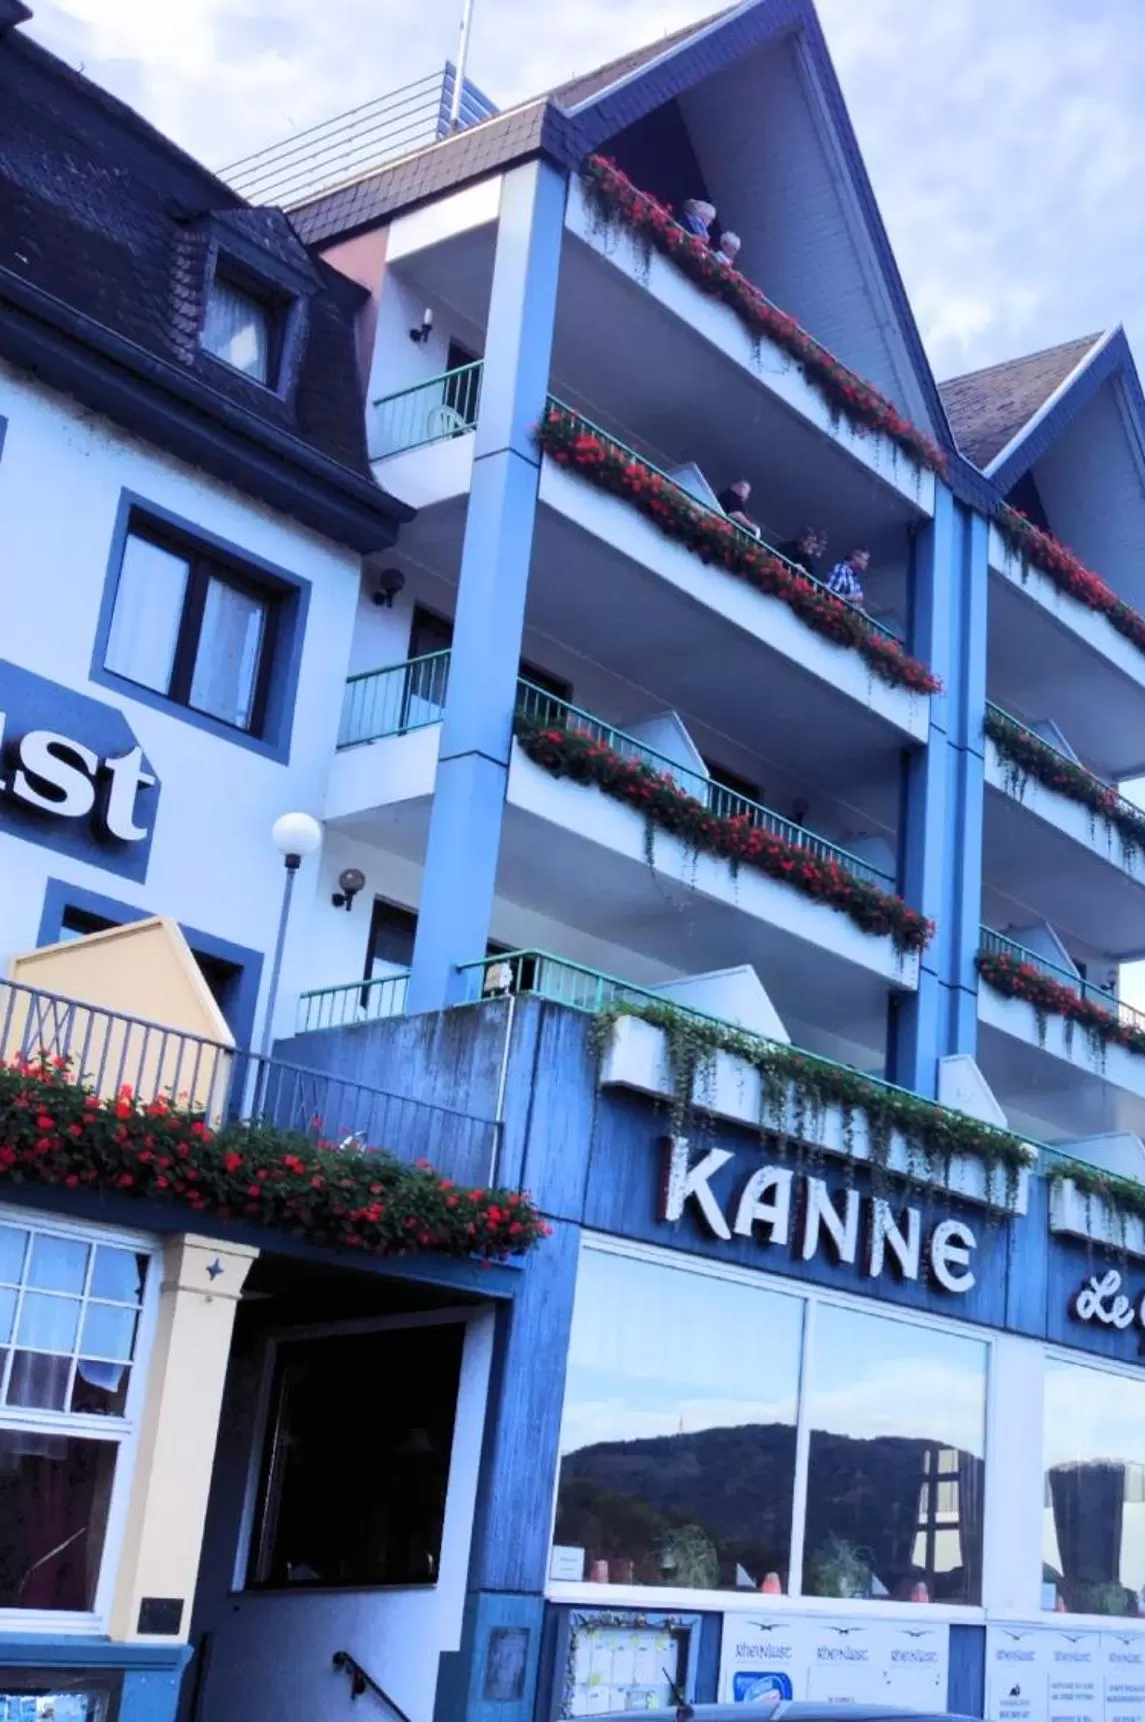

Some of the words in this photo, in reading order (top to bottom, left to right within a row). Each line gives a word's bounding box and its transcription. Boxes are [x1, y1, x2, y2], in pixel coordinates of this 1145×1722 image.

[0, 711, 155, 841] st
[664, 1136, 977, 1292] KANNE
[1076, 1269, 1135, 1329] Le
